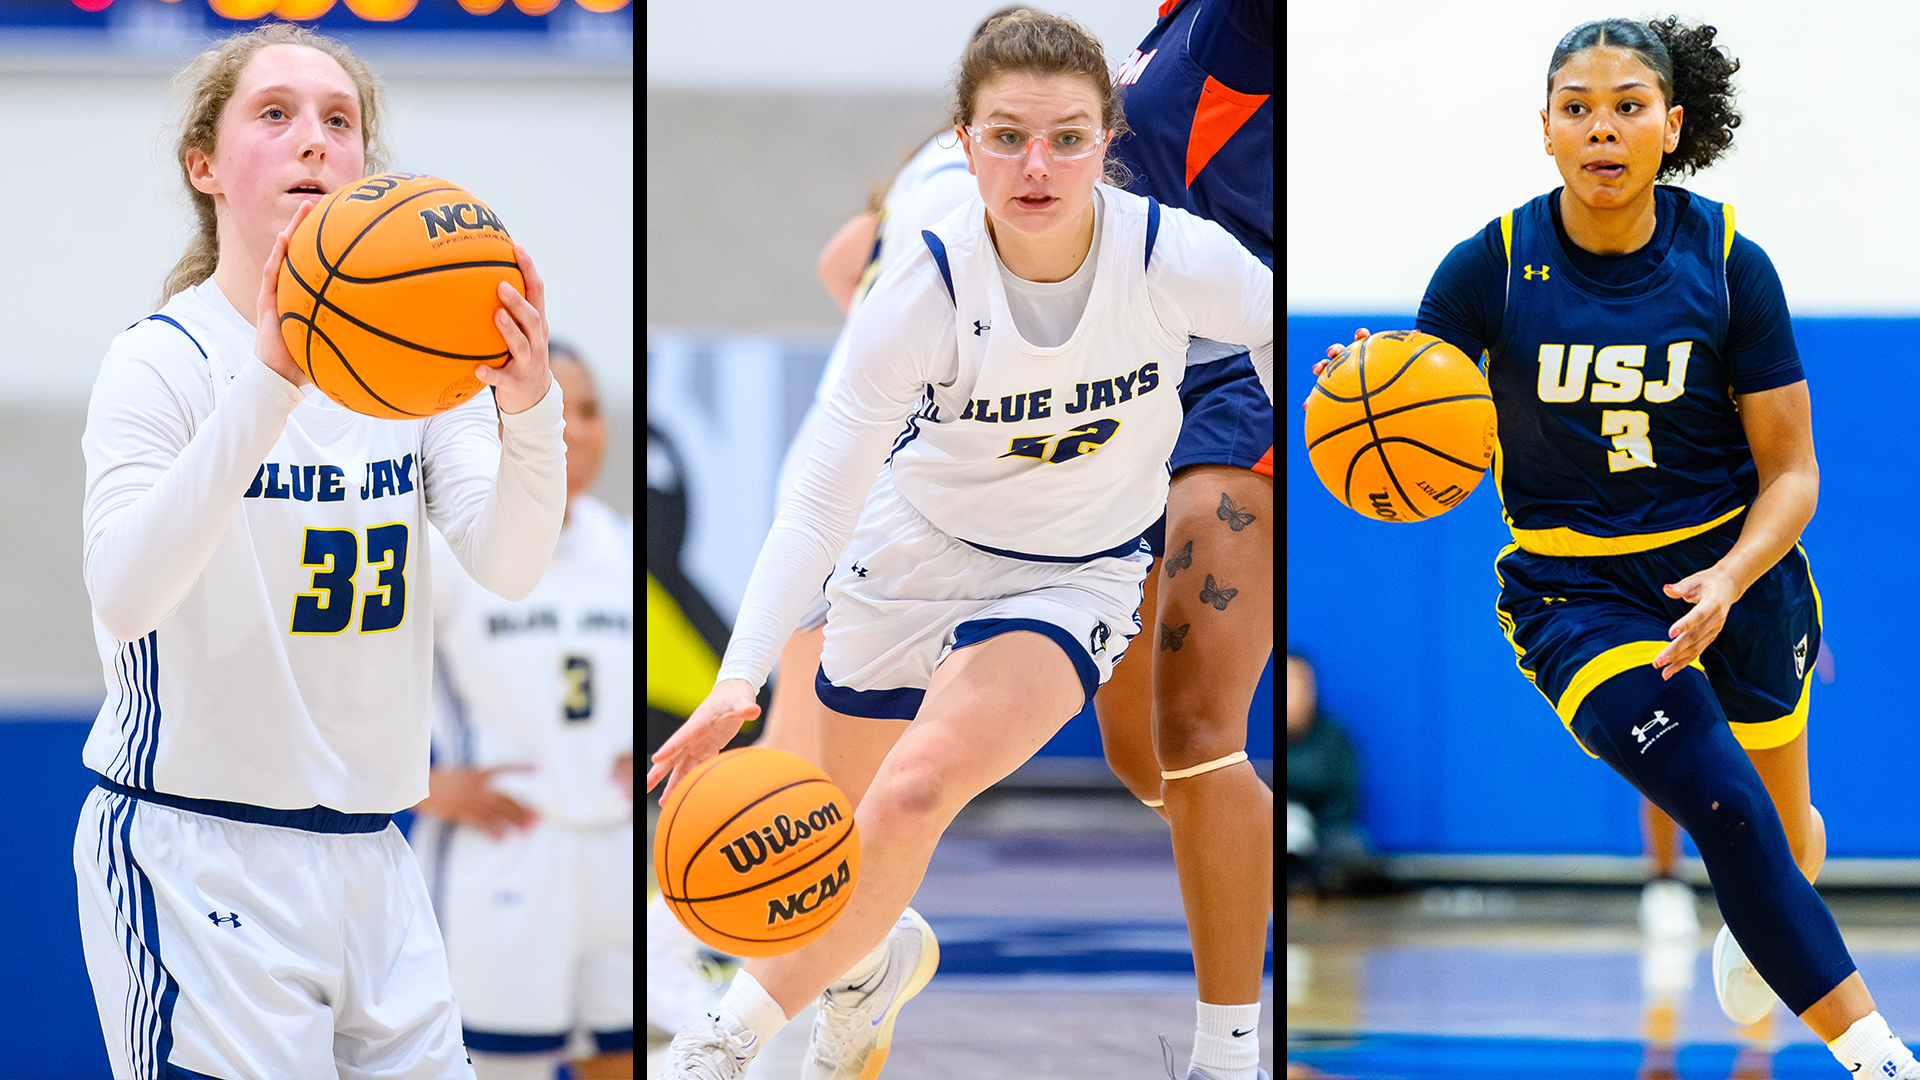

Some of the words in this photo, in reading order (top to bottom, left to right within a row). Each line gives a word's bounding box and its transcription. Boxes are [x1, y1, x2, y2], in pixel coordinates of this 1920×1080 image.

[1064, 361, 1160, 415] JAYS
[1537, 340, 1693, 404] USJ
[1601, 409, 1657, 473] 3
[359, 451, 421, 502] JAY
[288, 520, 411, 636] 33
[562, 653, 595, 723] 3
[719, 802, 844, 874] Wilson
[766, 858, 851, 926] NCAA
